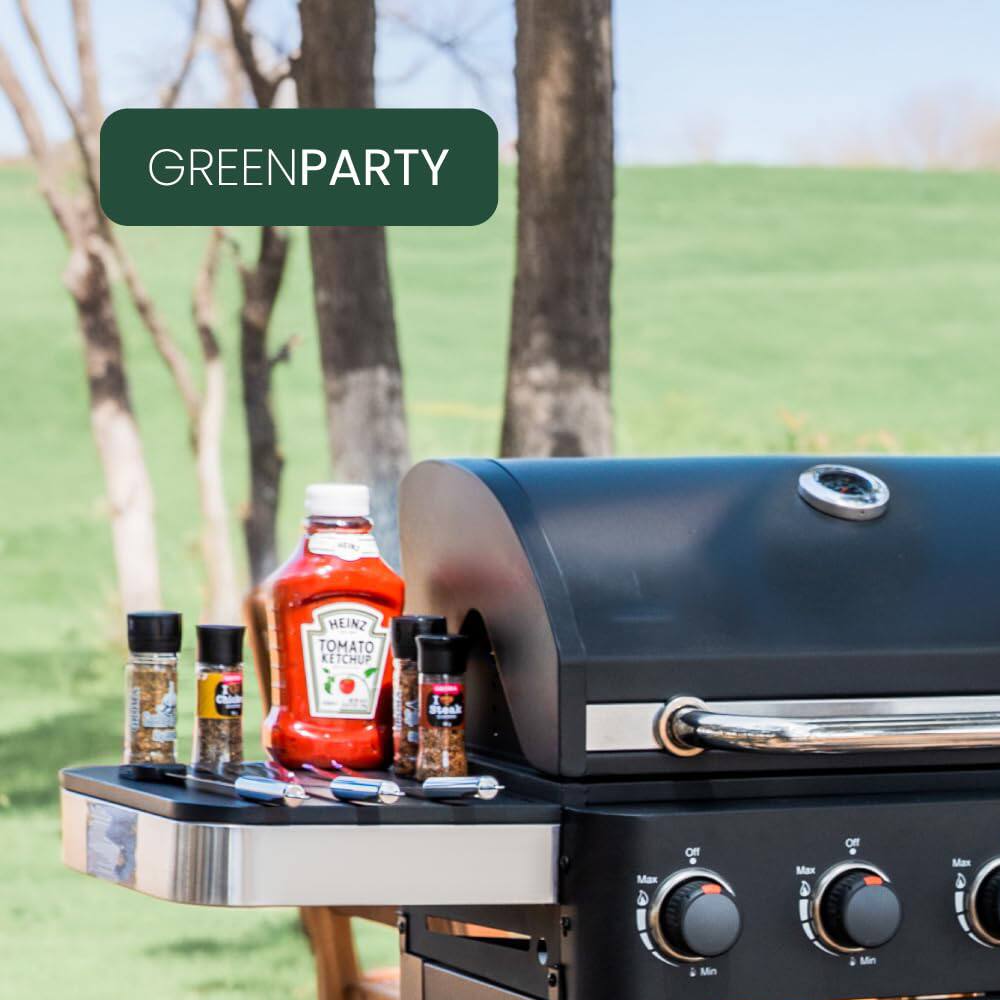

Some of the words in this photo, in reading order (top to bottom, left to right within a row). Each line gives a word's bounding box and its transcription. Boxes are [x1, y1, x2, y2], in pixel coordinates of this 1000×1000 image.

[329, 617, 367, 632] HEINZ
[319, 639, 375, 654] TOMATO
[321, 653, 372, 665] KETCHUP
[428, 704, 463, 715] Steak
[844, 837, 860, 848] Off
[684, 846, 700, 858] Off
[951, 857, 972, 868] Max
[796, 865, 816, 876] Max
[636, 874, 658, 885] Max
[859, 955, 877, 966] Min
[700, 966, 718, 977] Min
